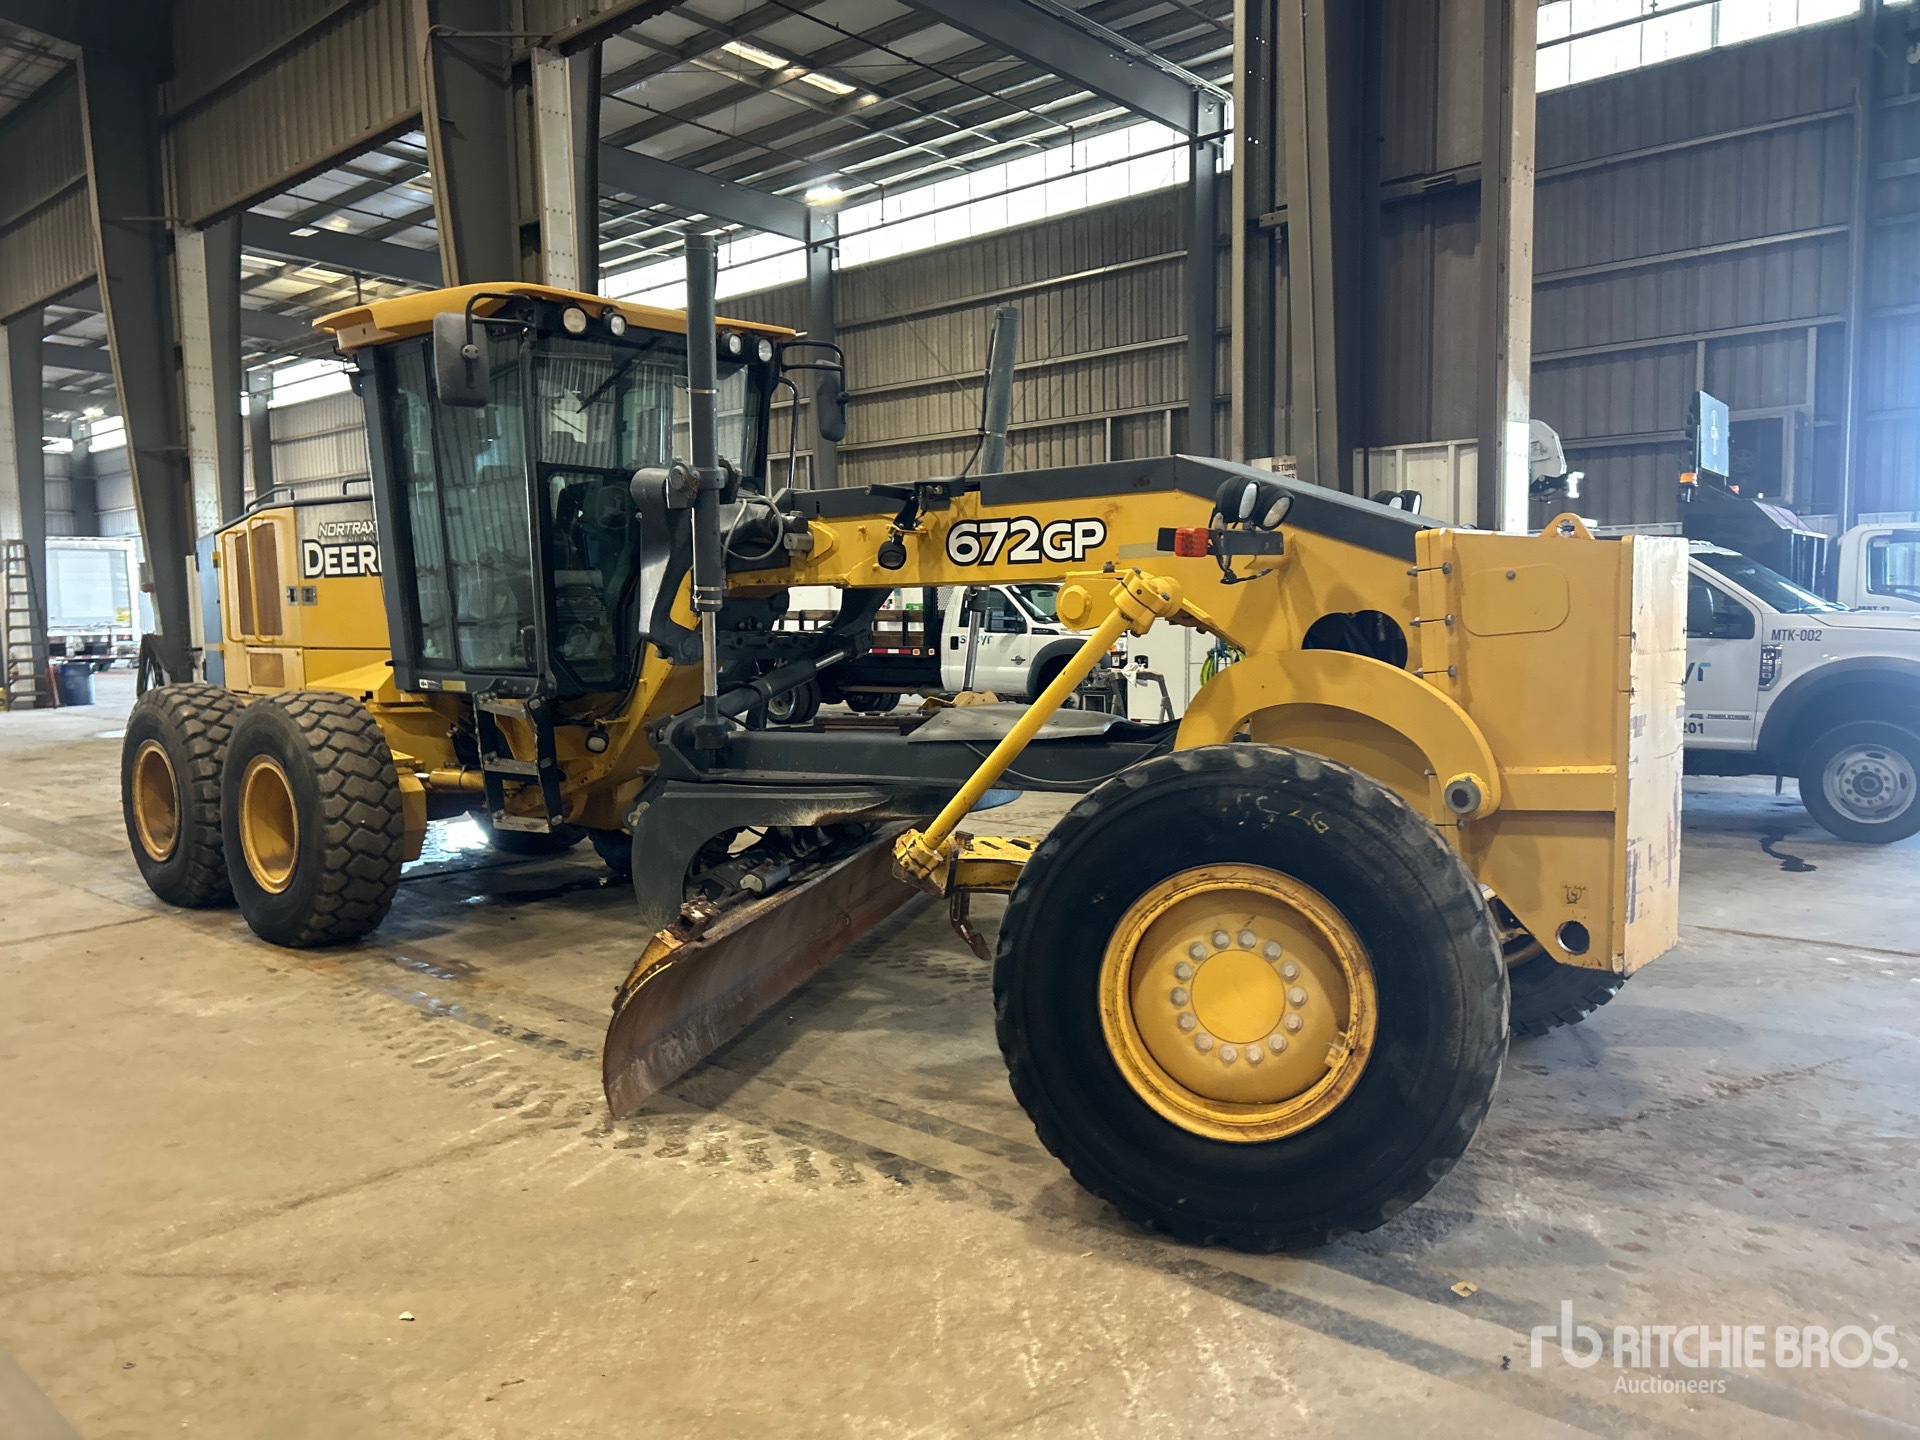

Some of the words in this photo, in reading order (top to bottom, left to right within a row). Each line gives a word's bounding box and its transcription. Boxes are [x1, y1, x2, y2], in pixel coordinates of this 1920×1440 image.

[318, 520, 377, 537] NORTRAX
[947, 517, 1105, 565] 672GP
[303, 540, 382, 577] DEER
[1771, 629, 1822, 642] MTK-002
